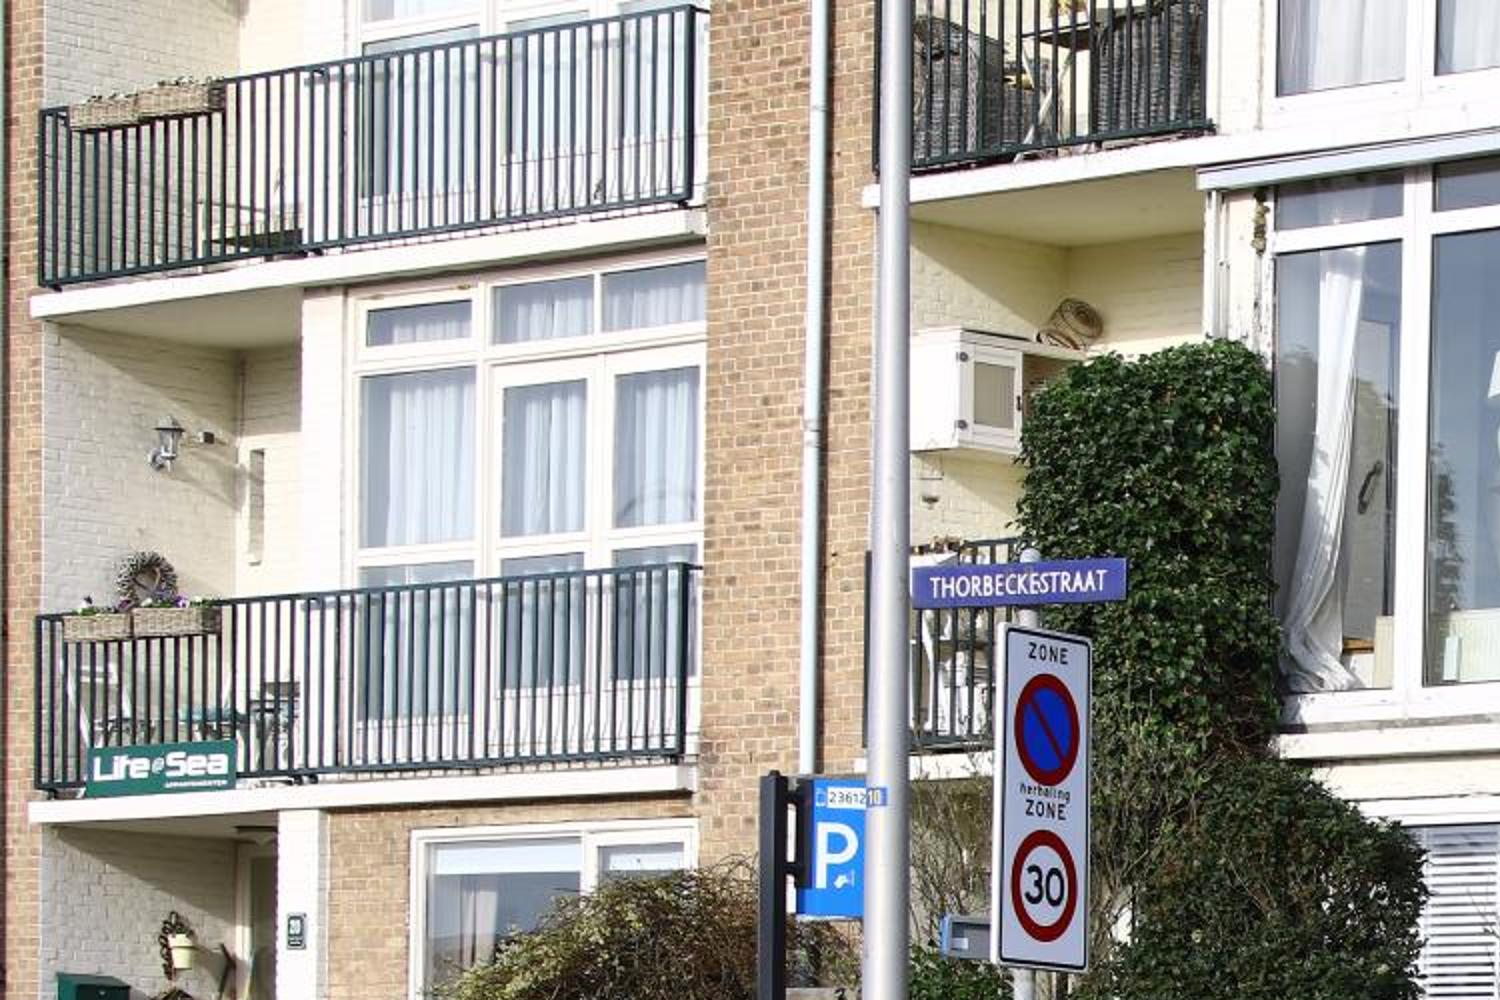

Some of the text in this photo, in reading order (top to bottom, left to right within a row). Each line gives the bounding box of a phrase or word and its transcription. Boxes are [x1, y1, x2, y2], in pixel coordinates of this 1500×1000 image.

[929, 569, 1109, 600] THORBECKESTRAAT
[1028, 641, 1069, 665] ZONE
[1019, 782, 1071, 805] herhaling
[1025, 799, 1066, 821] ZONE
[815, 821, 859, 889] P
[1024, 864, 1065, 907] 30
